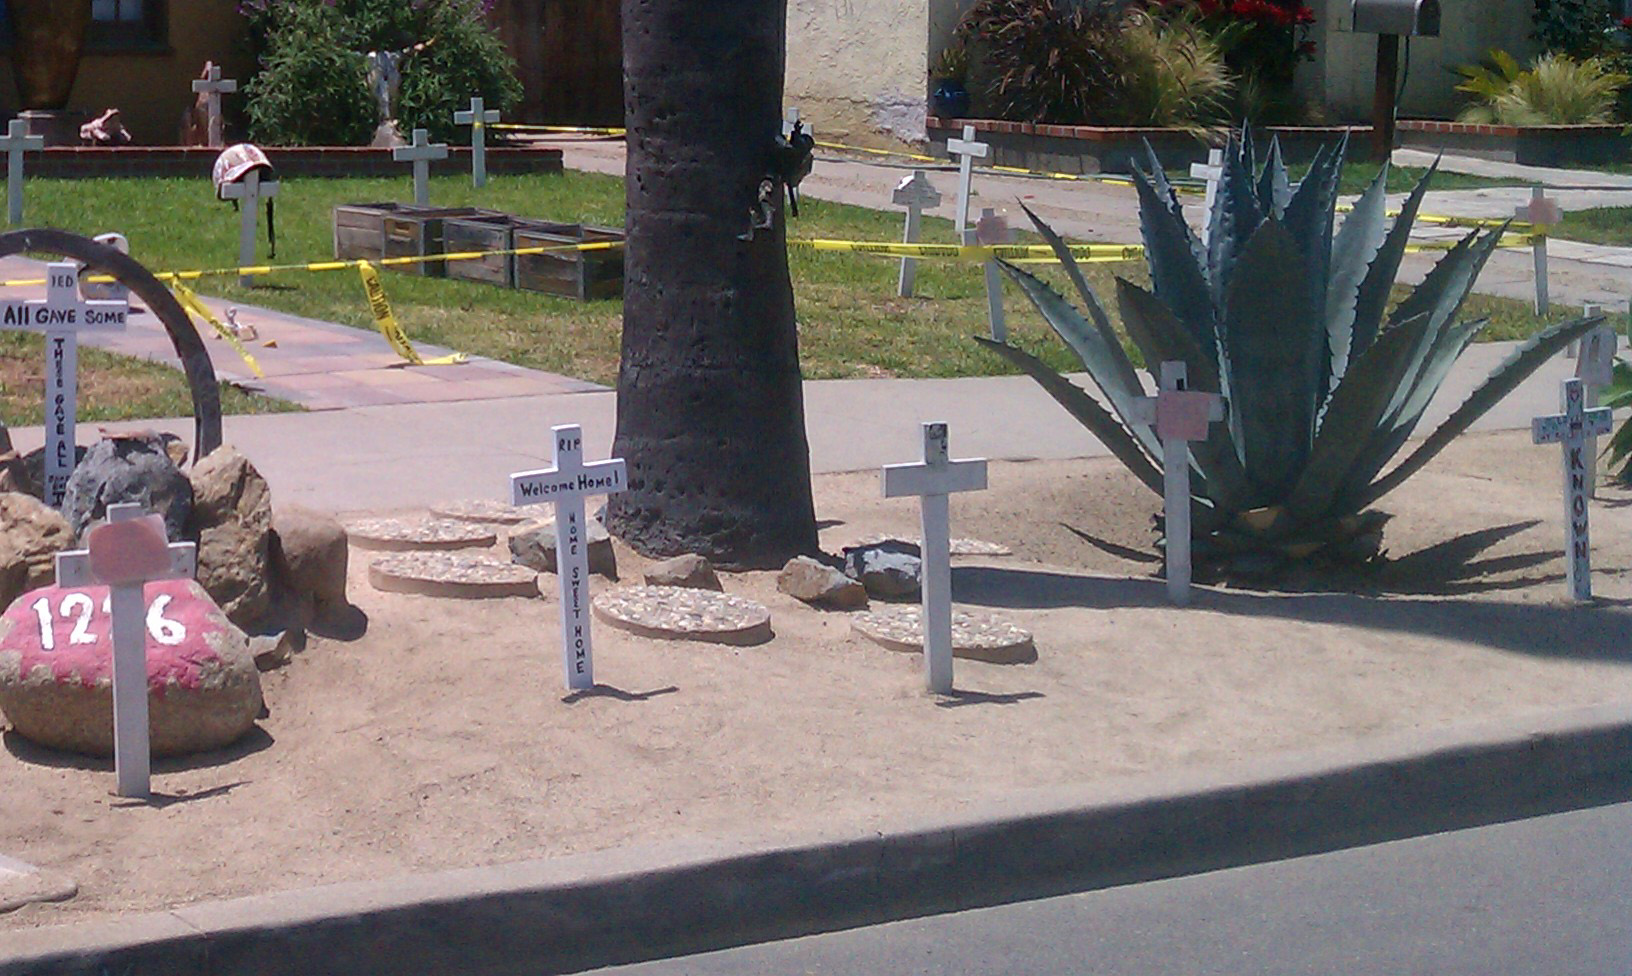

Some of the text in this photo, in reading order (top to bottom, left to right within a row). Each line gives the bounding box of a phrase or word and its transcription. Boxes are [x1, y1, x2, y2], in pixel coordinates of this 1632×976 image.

[35, 307, 76, 325] GAVE
[85, 310, 125, 325] SOME
[558, 437, 581, 452] RIP
[520, 479, 575, 498] Welcome
[32, 592, 186, 650] 126
[574, 625, 586, 675] HOME
